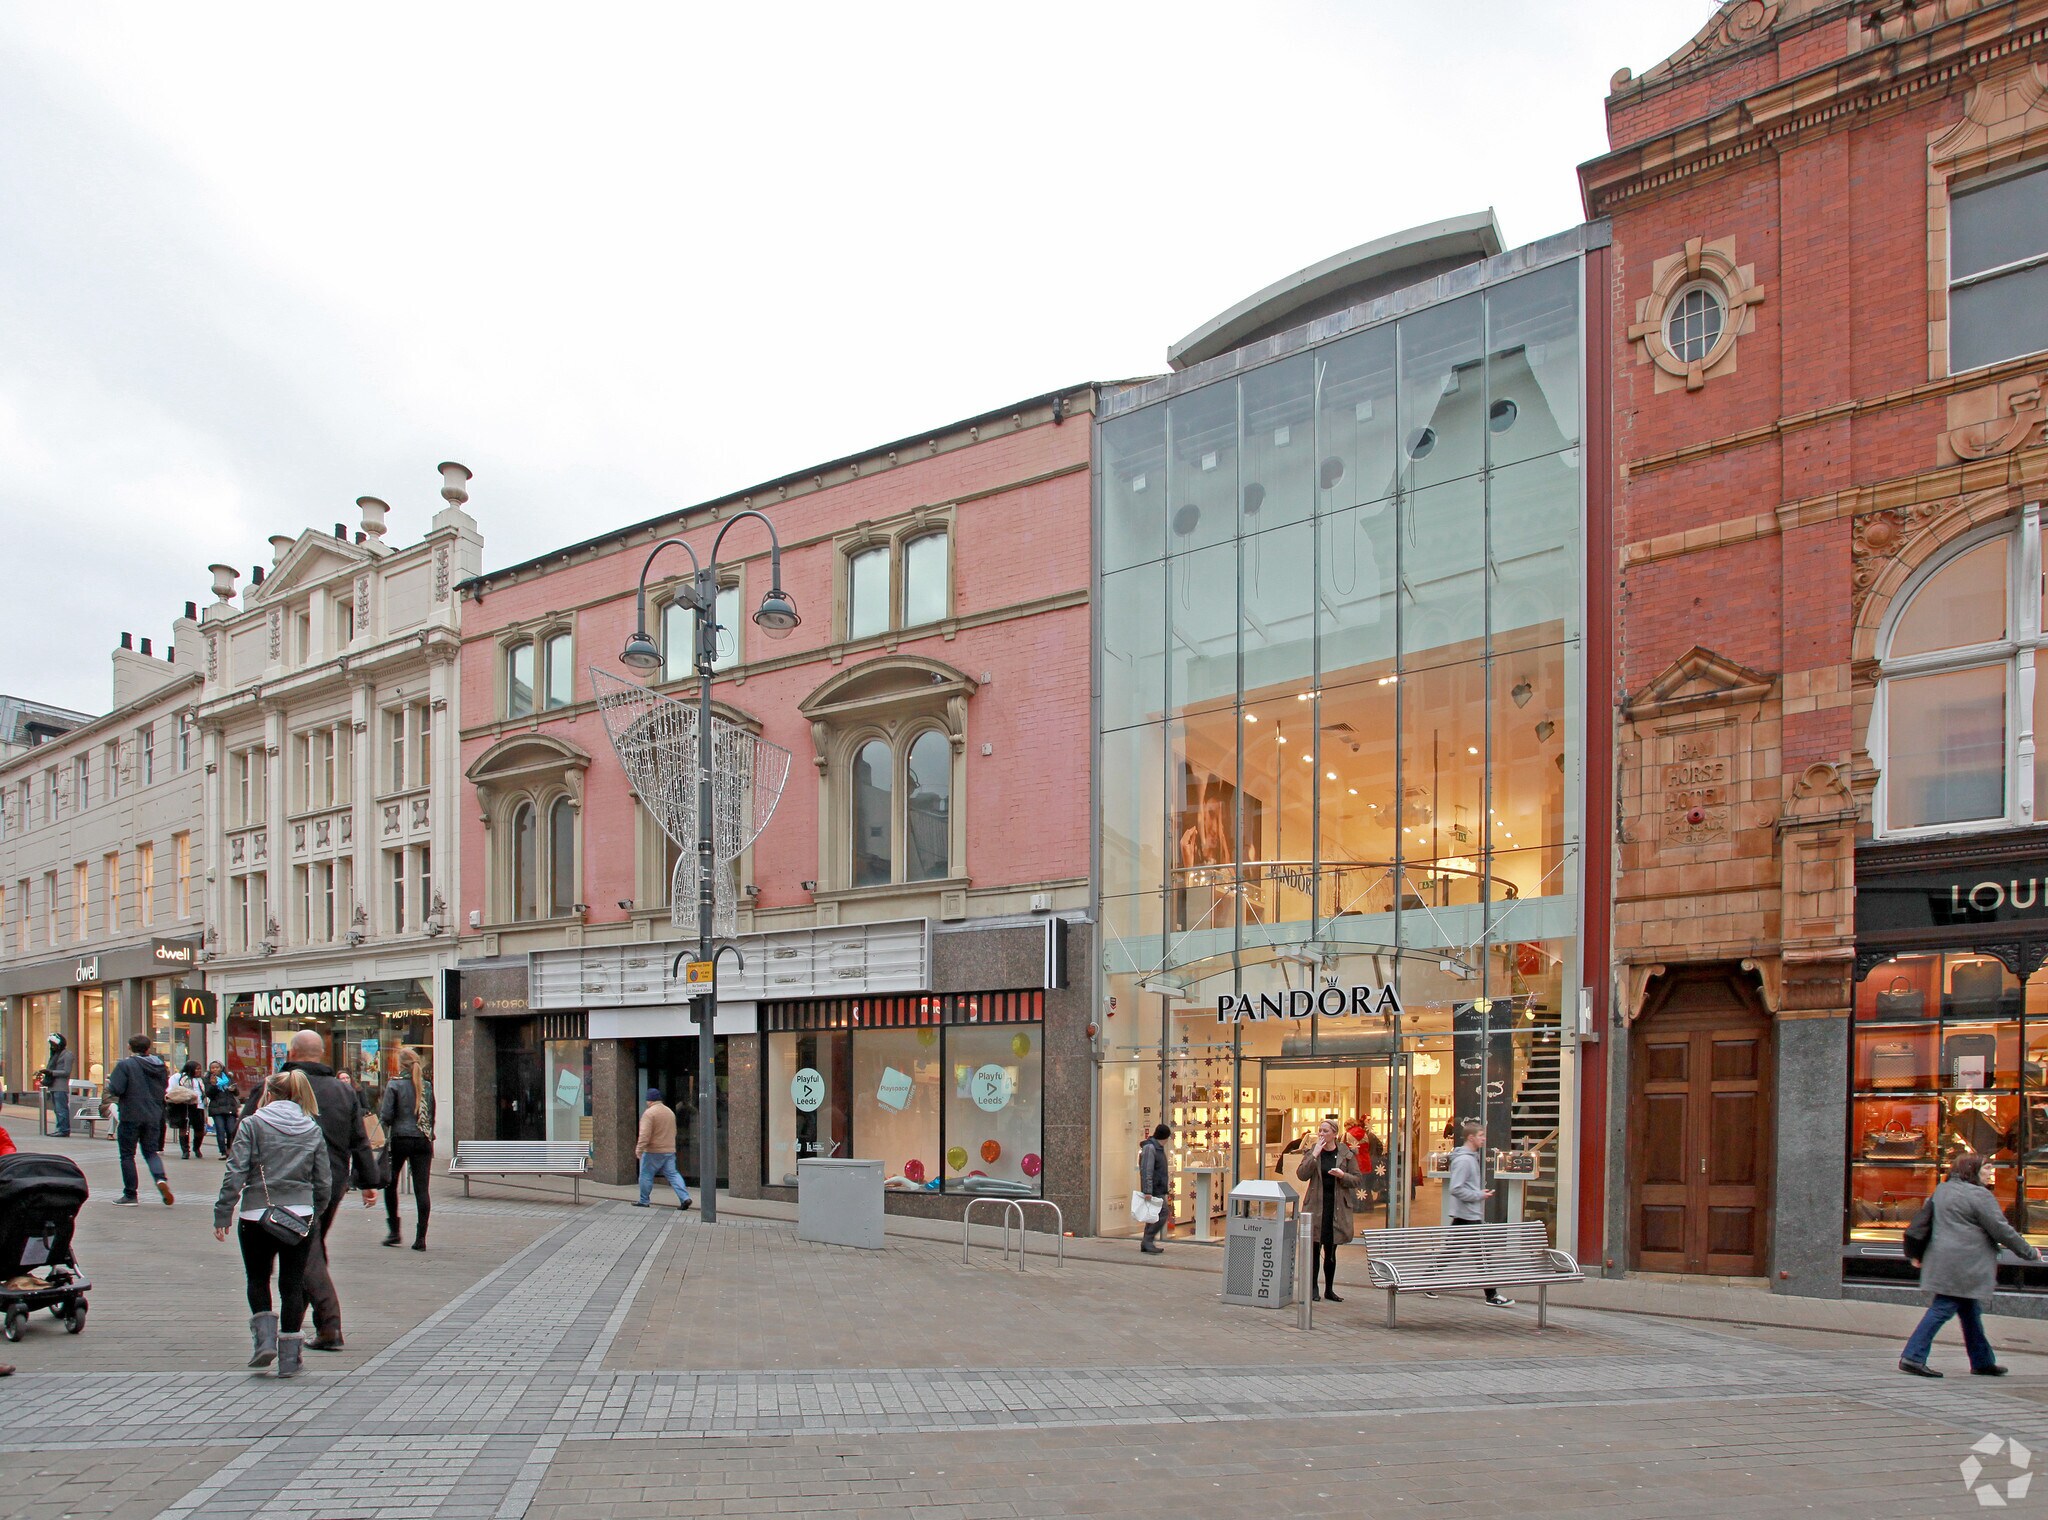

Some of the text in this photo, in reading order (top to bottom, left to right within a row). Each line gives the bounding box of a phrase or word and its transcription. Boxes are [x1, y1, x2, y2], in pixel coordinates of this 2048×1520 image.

[1679, 742, 1714, 761] BAY
[1667, 763, 1725, 787] HORSE
[1665, 789, 1726, 812] HOTEL
[156, 945, 190, 961] dwell
[76, 957, 99, 982] dwell
[253, 985, 366, 1017] McDonald's
[1217, 981, 1403, 1024] PANDORA
[796, 1075, 820, 1084] Playful
[978, 1096, 1003, 1105] Leeds
[1243, 1224, 1263, 1232] Litter
[1257, 1237, 1274, 1299] Briggate
